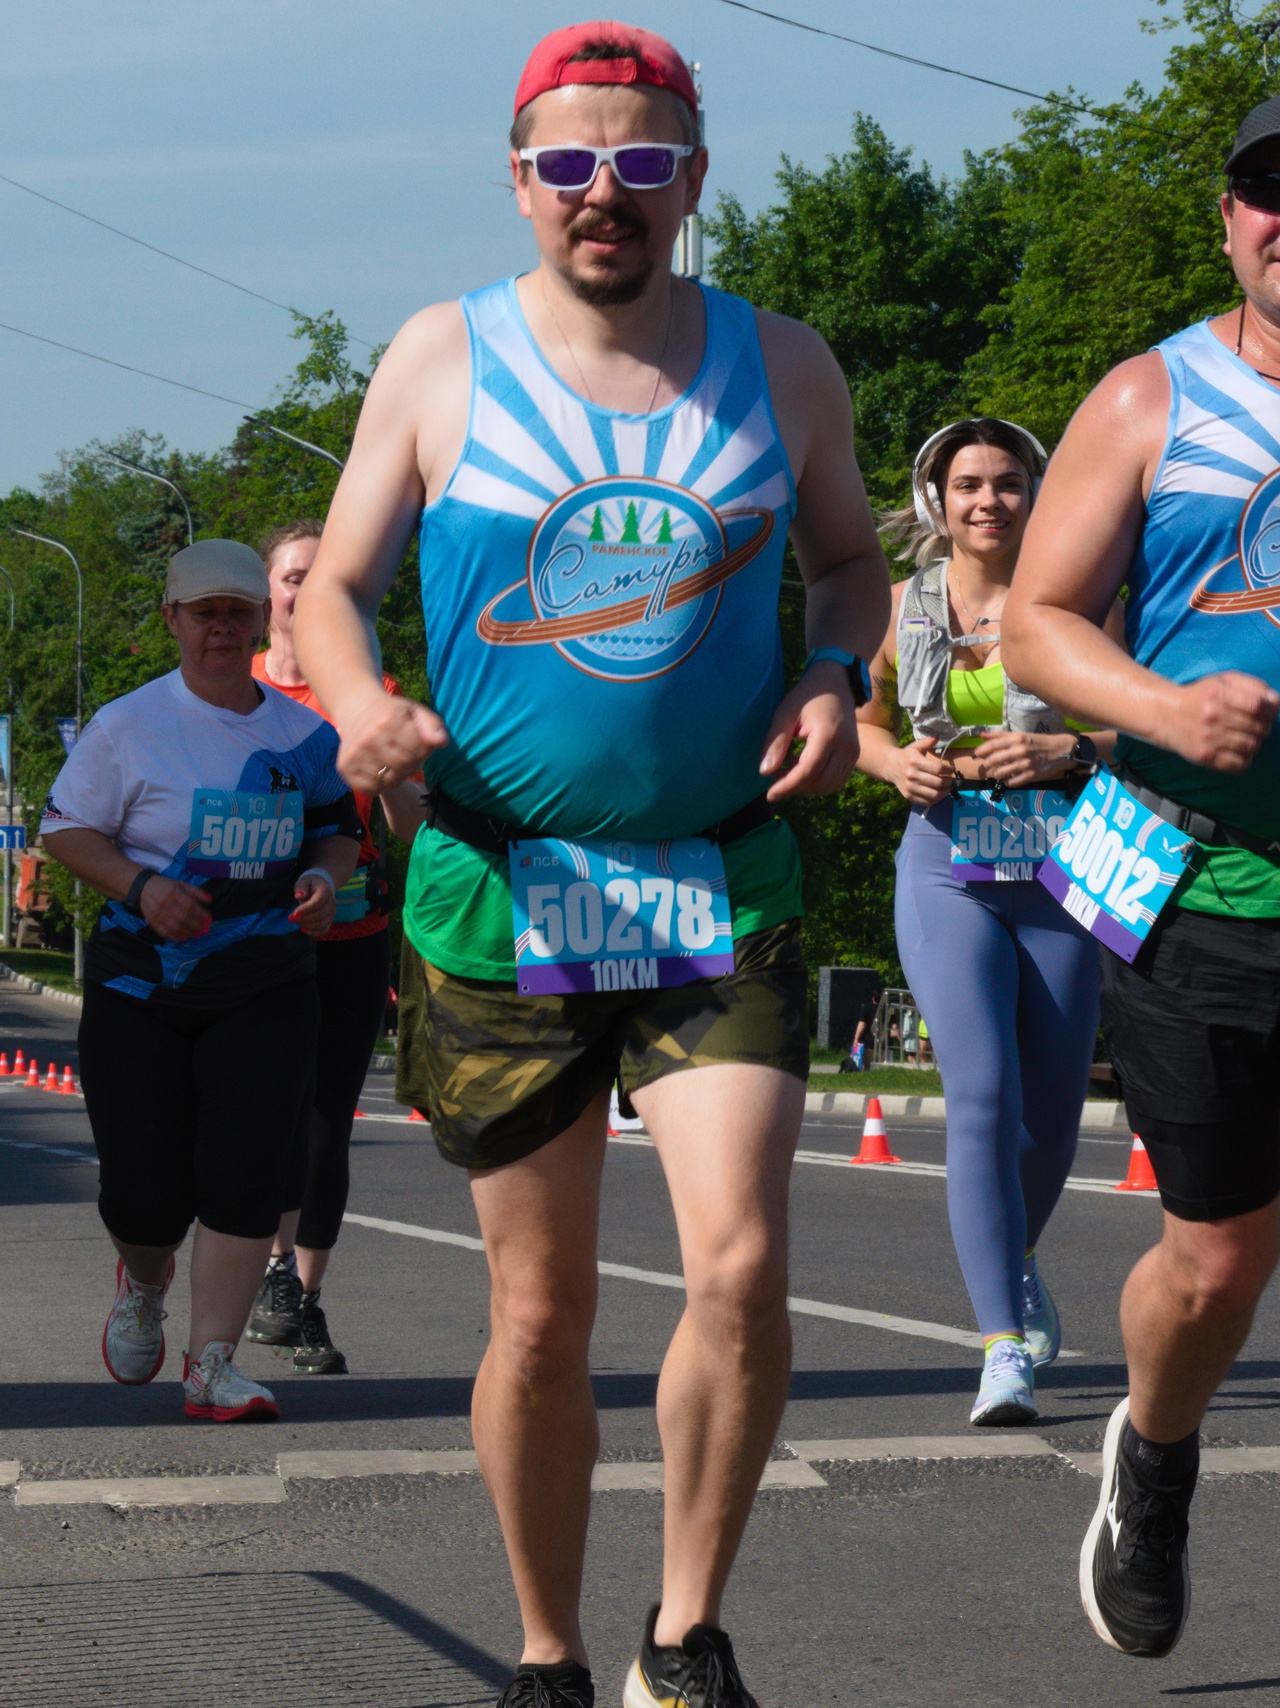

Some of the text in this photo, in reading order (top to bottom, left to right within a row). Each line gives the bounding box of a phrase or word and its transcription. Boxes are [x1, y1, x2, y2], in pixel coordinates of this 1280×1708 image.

[592, 544, 669, 557] РАМЕНСКОЕ
[538, 538, 724, 624] Сатурн
[200, 814, 296, 858] 50176
[228, 860, 266, 880] 10KM
[533, 855, 560, 867] ПСБ
[993, 862, 1034, 881] 10KM
[1059, 798, 1161, 926] 50012
[527, 876, 716, 958] 50278
[1062, 881, 1101, 932] 10KM
[590, 957, 659, 992] 10KM
